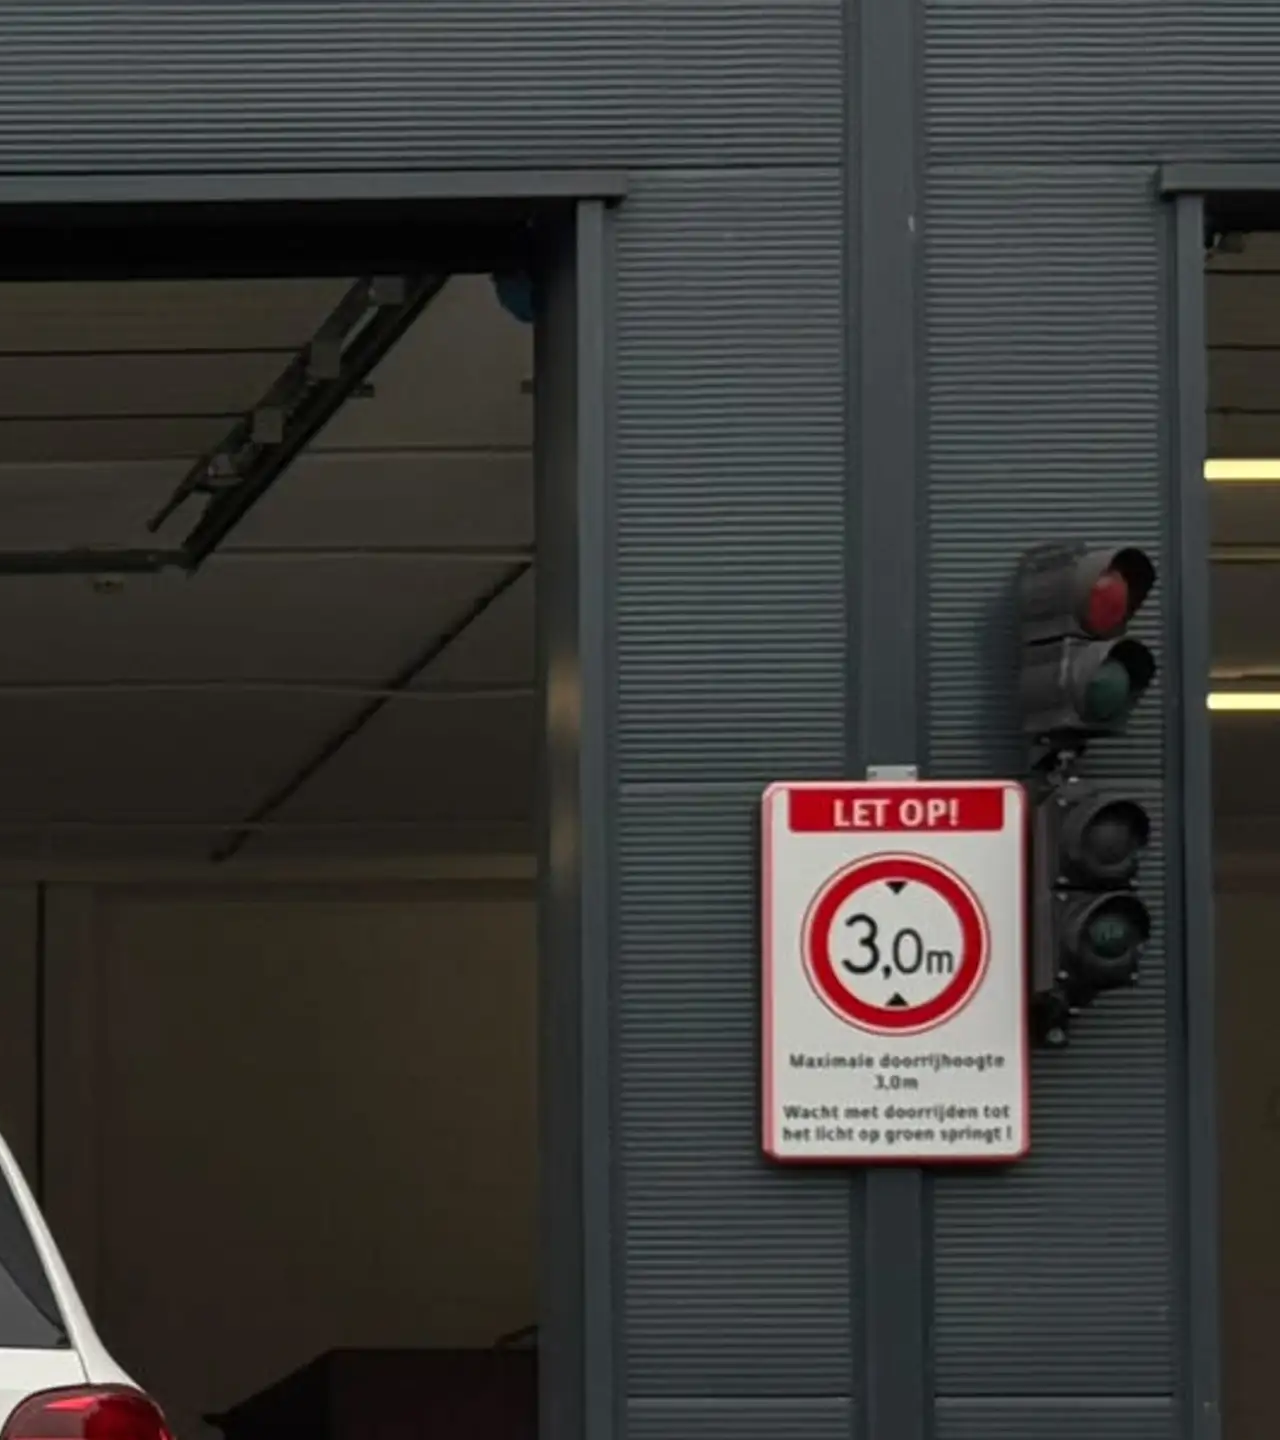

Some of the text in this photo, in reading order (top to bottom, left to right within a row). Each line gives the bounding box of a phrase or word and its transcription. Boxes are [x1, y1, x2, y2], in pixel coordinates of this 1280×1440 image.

[833, 798, 959, 827] LET OP!
[842, 913, 954, 979] 3,0m
[789, 1053, 1005, 1072] Maximale doorrijhoogte
[783, 1104, 1011, 1122] Wacht met doorrijden tot
[782, 1126, 811, 1141] het
[815, 1126, 854, 1141] licht
[858, 1128, 880, 1144] op
[884, 1128, 935, 1144] groen
